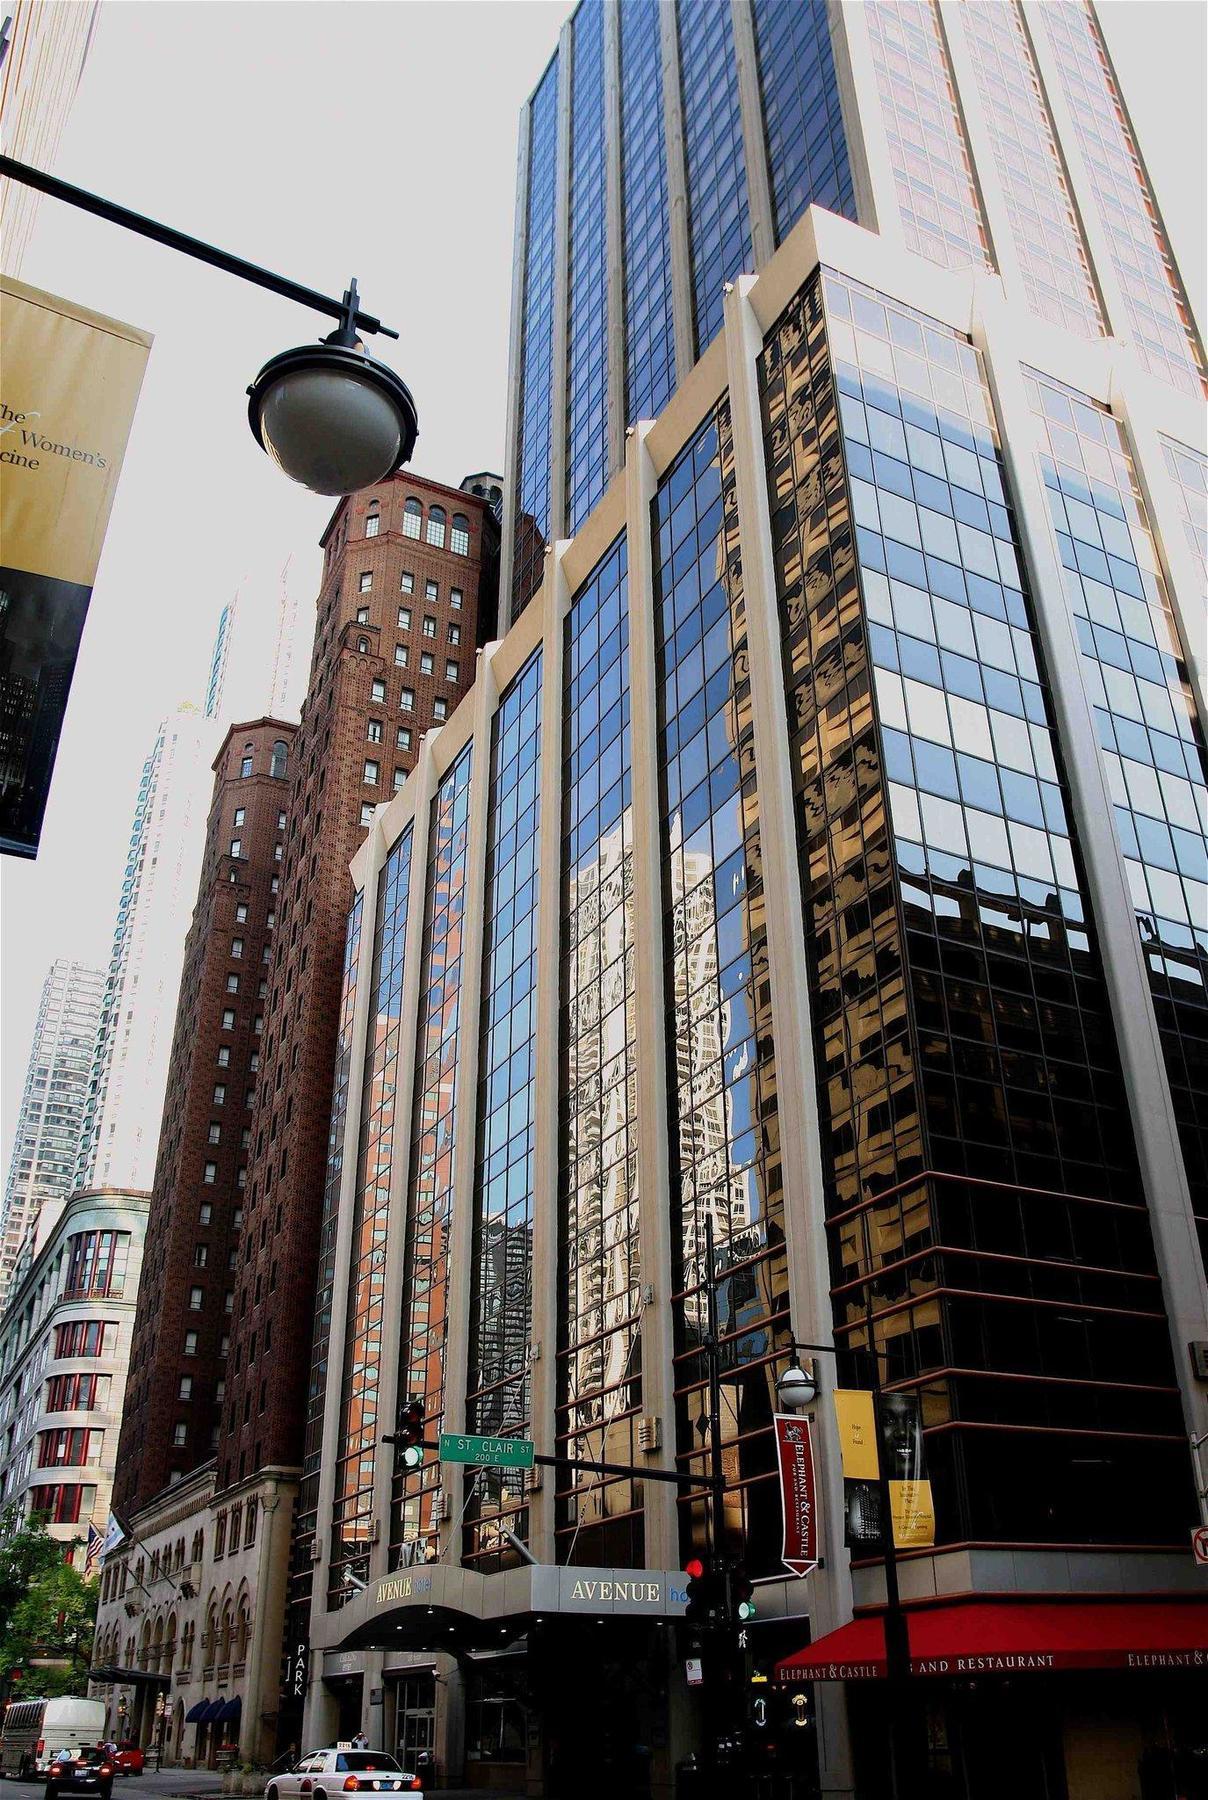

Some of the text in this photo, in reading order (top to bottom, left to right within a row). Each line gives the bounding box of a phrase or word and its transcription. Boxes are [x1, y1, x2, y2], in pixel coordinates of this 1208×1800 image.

[21, 429, 107, 468] Women's
[444, 1439, 530, 1454] N ST. CLAIR ST
[475, 1453, 500, 1462] 200 E
[795, 1444, 808, 1500] ELEPHANT
[800, 1515, 810, 1557] CASTLE
[376, 1577, 412, 1604] AVENUE
[570, 1580, 660, 1602] AVENUE
[294, 1644, 305, 1696] PARK
[919, 1660, 949, 1673] AND
[957, 1655, 1053, 1670] RESTAURANT
[1128, 1653, 1190, 1666] ELEPHANT
[780, 1667, 827, 1681] ELEPHANT
[839, 1665, 878, 1678] CASTLE
